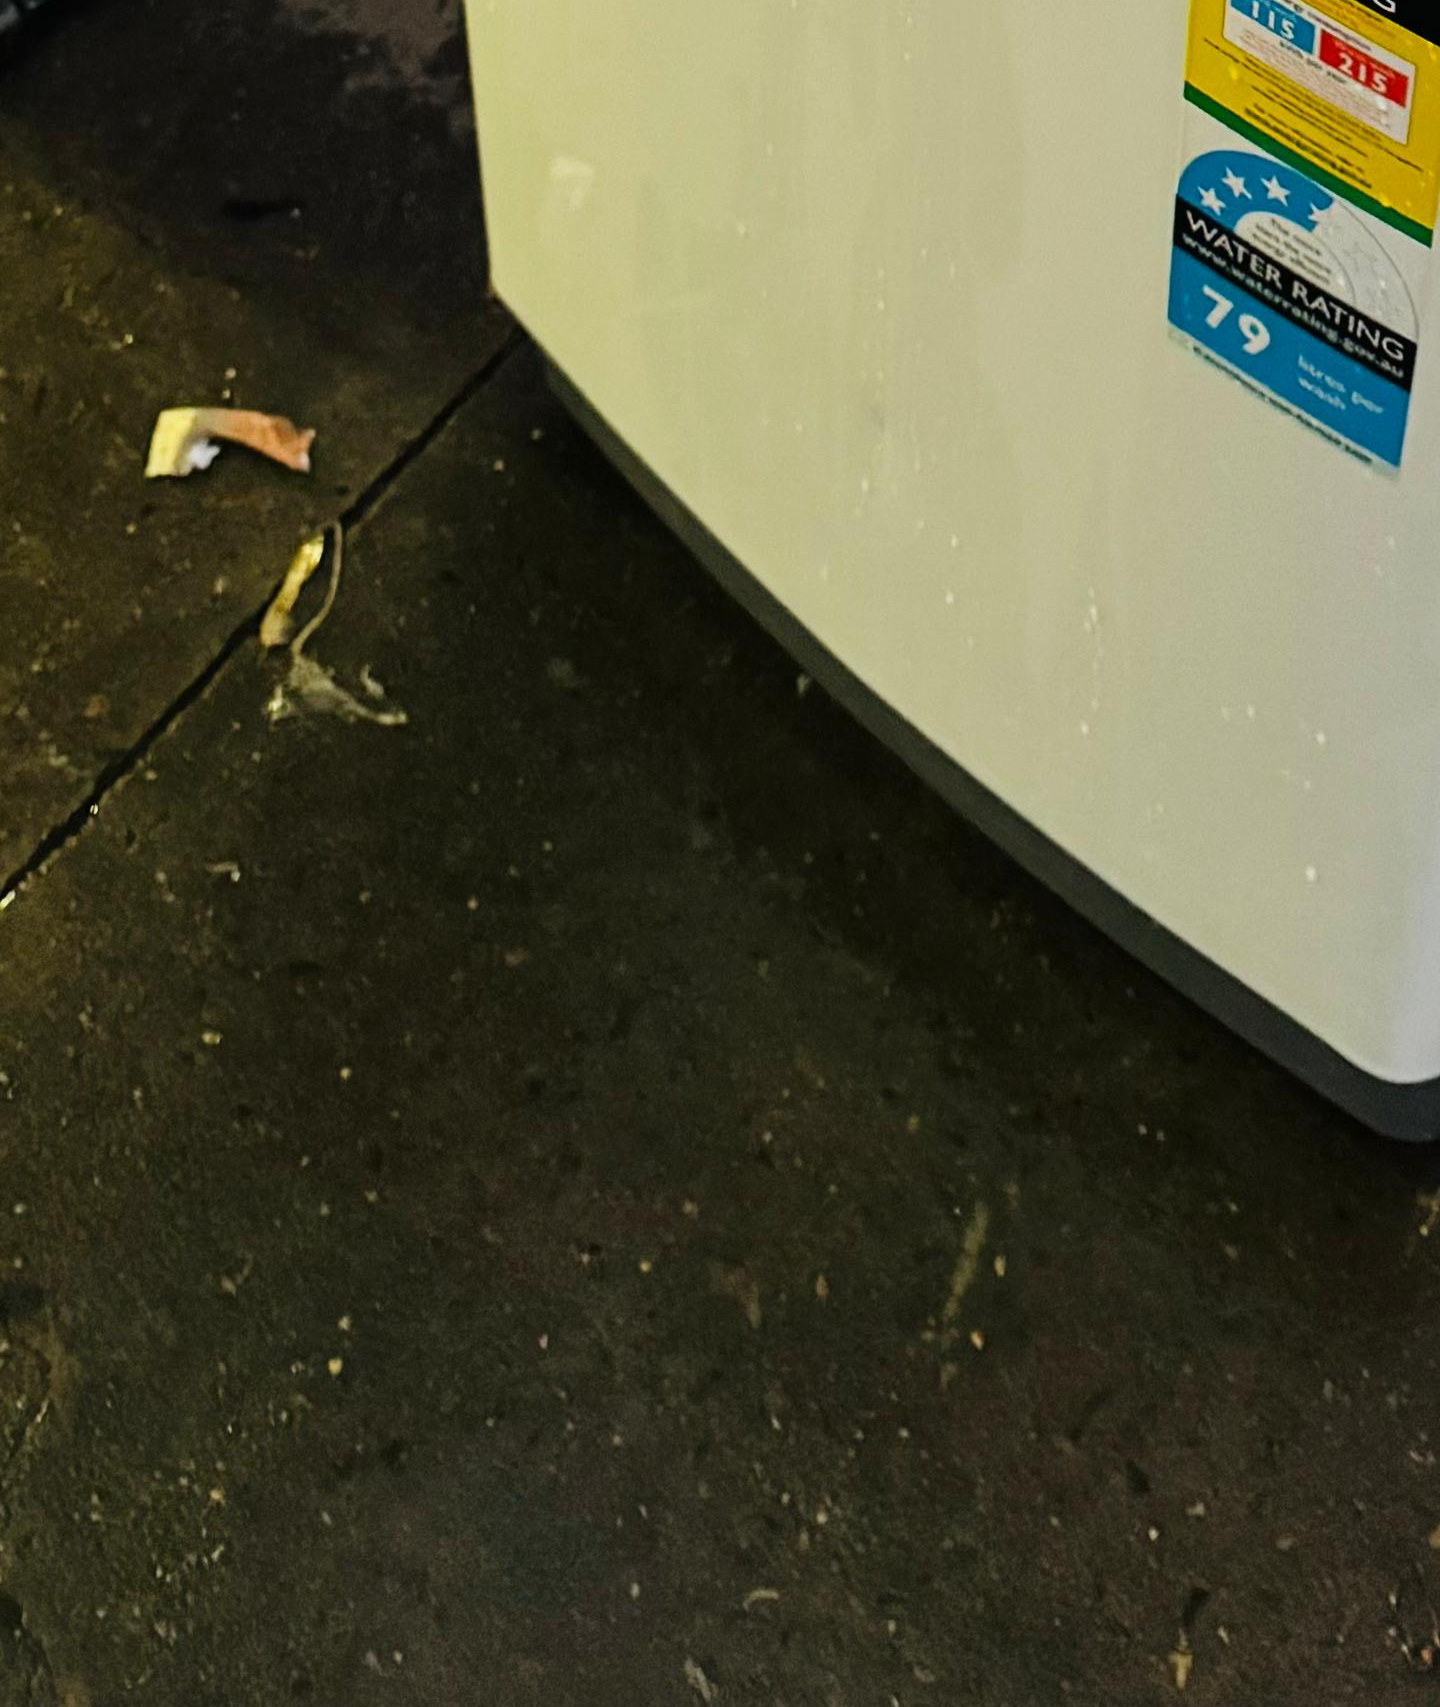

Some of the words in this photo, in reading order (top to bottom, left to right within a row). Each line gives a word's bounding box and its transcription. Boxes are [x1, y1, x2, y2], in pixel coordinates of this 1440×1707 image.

[1249, 0, 1295, 40] 115
[1338, 52, 1387, 93] 215
[1182, 233, 1405, 378] www.waterrating.gov.au
[1185, 212, 1282, 290] WATER
[1292, 279, 1405, 362] RATING
[1202, 285, 1271, 355] 79
[1299, 378, 1346, 412] wash
[1352, 390, 1384, 415] per
